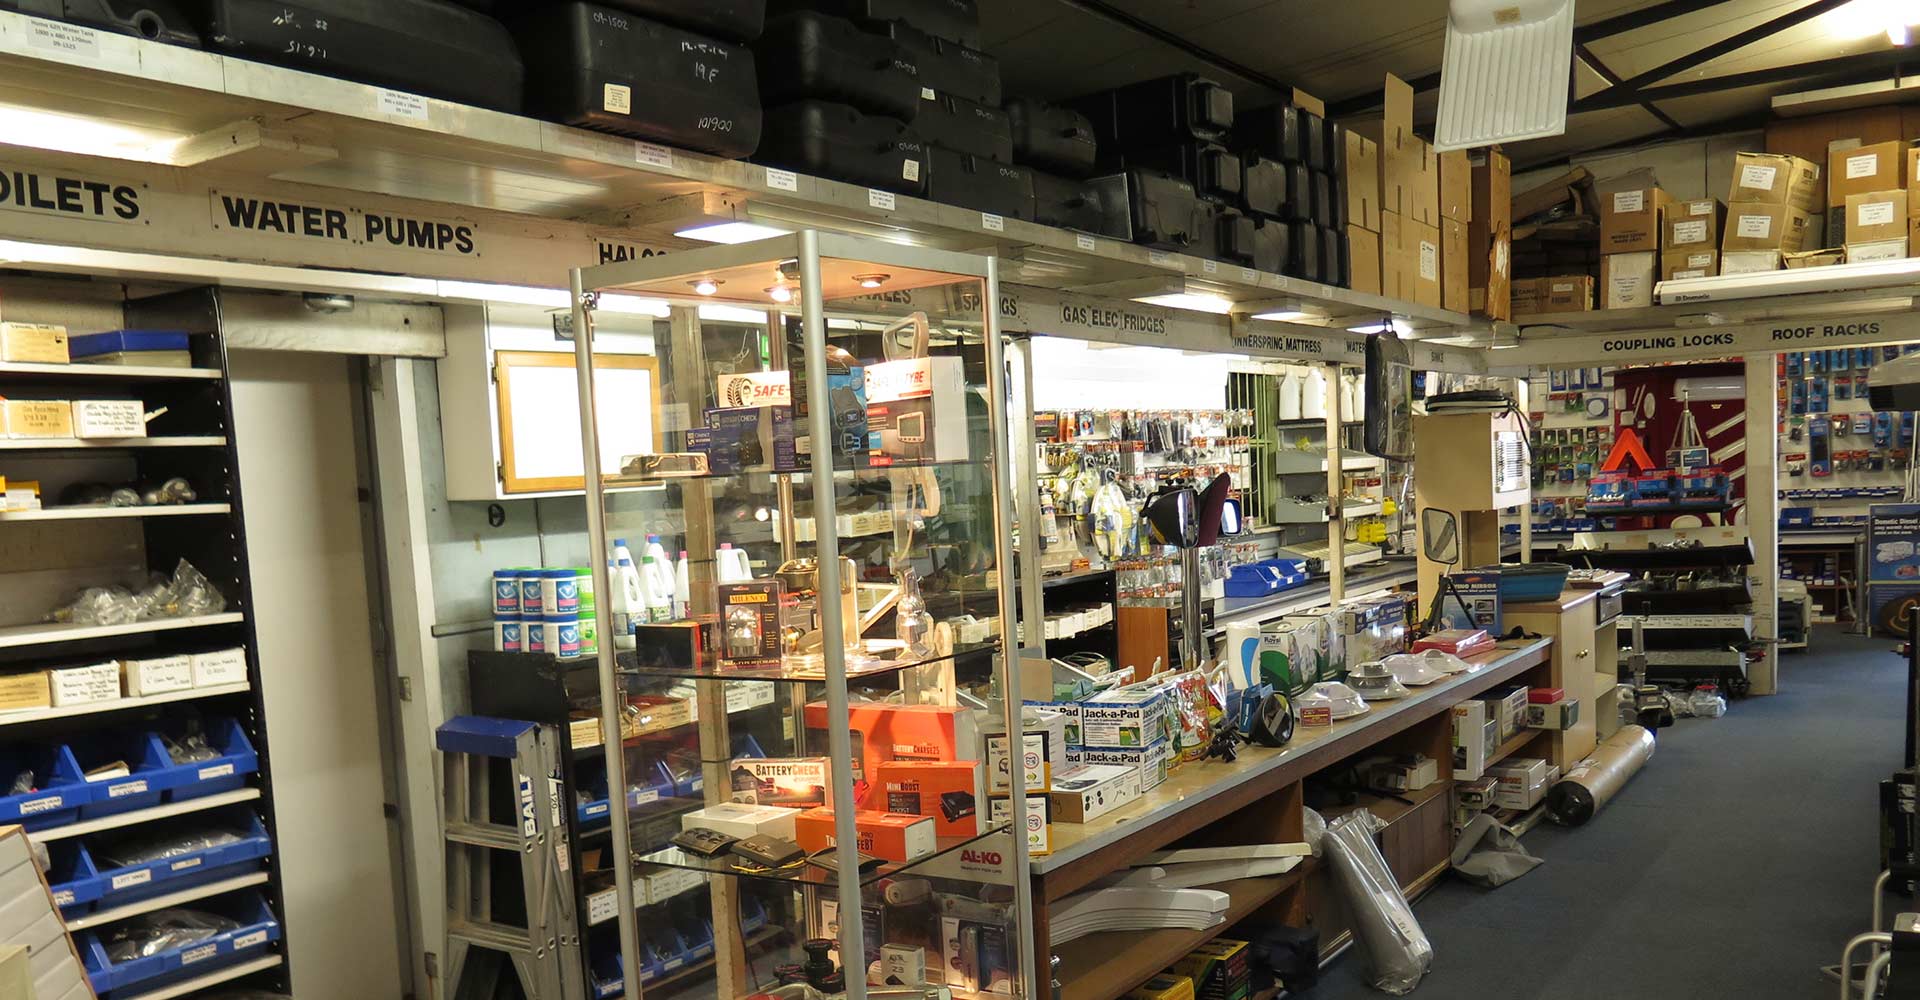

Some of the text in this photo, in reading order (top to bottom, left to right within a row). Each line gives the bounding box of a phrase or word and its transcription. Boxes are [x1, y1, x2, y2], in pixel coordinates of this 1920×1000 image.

[222, 196, 474, 254] WATER PUMPS
[1063, 306, 1165, 334] GAS ELEC FRIDGES
[1772, 323, 1880, 340] ROOF RACKS
[1235, 335, 1322, 353] INNERSPRING MATTRESS
[1604, 333, 1734, 351] COUPLING LOCKS
[1084, 709, 1140, 719] Jack-a-Pad
[1086, 753, 1140, 763] Jack-a-Pad
